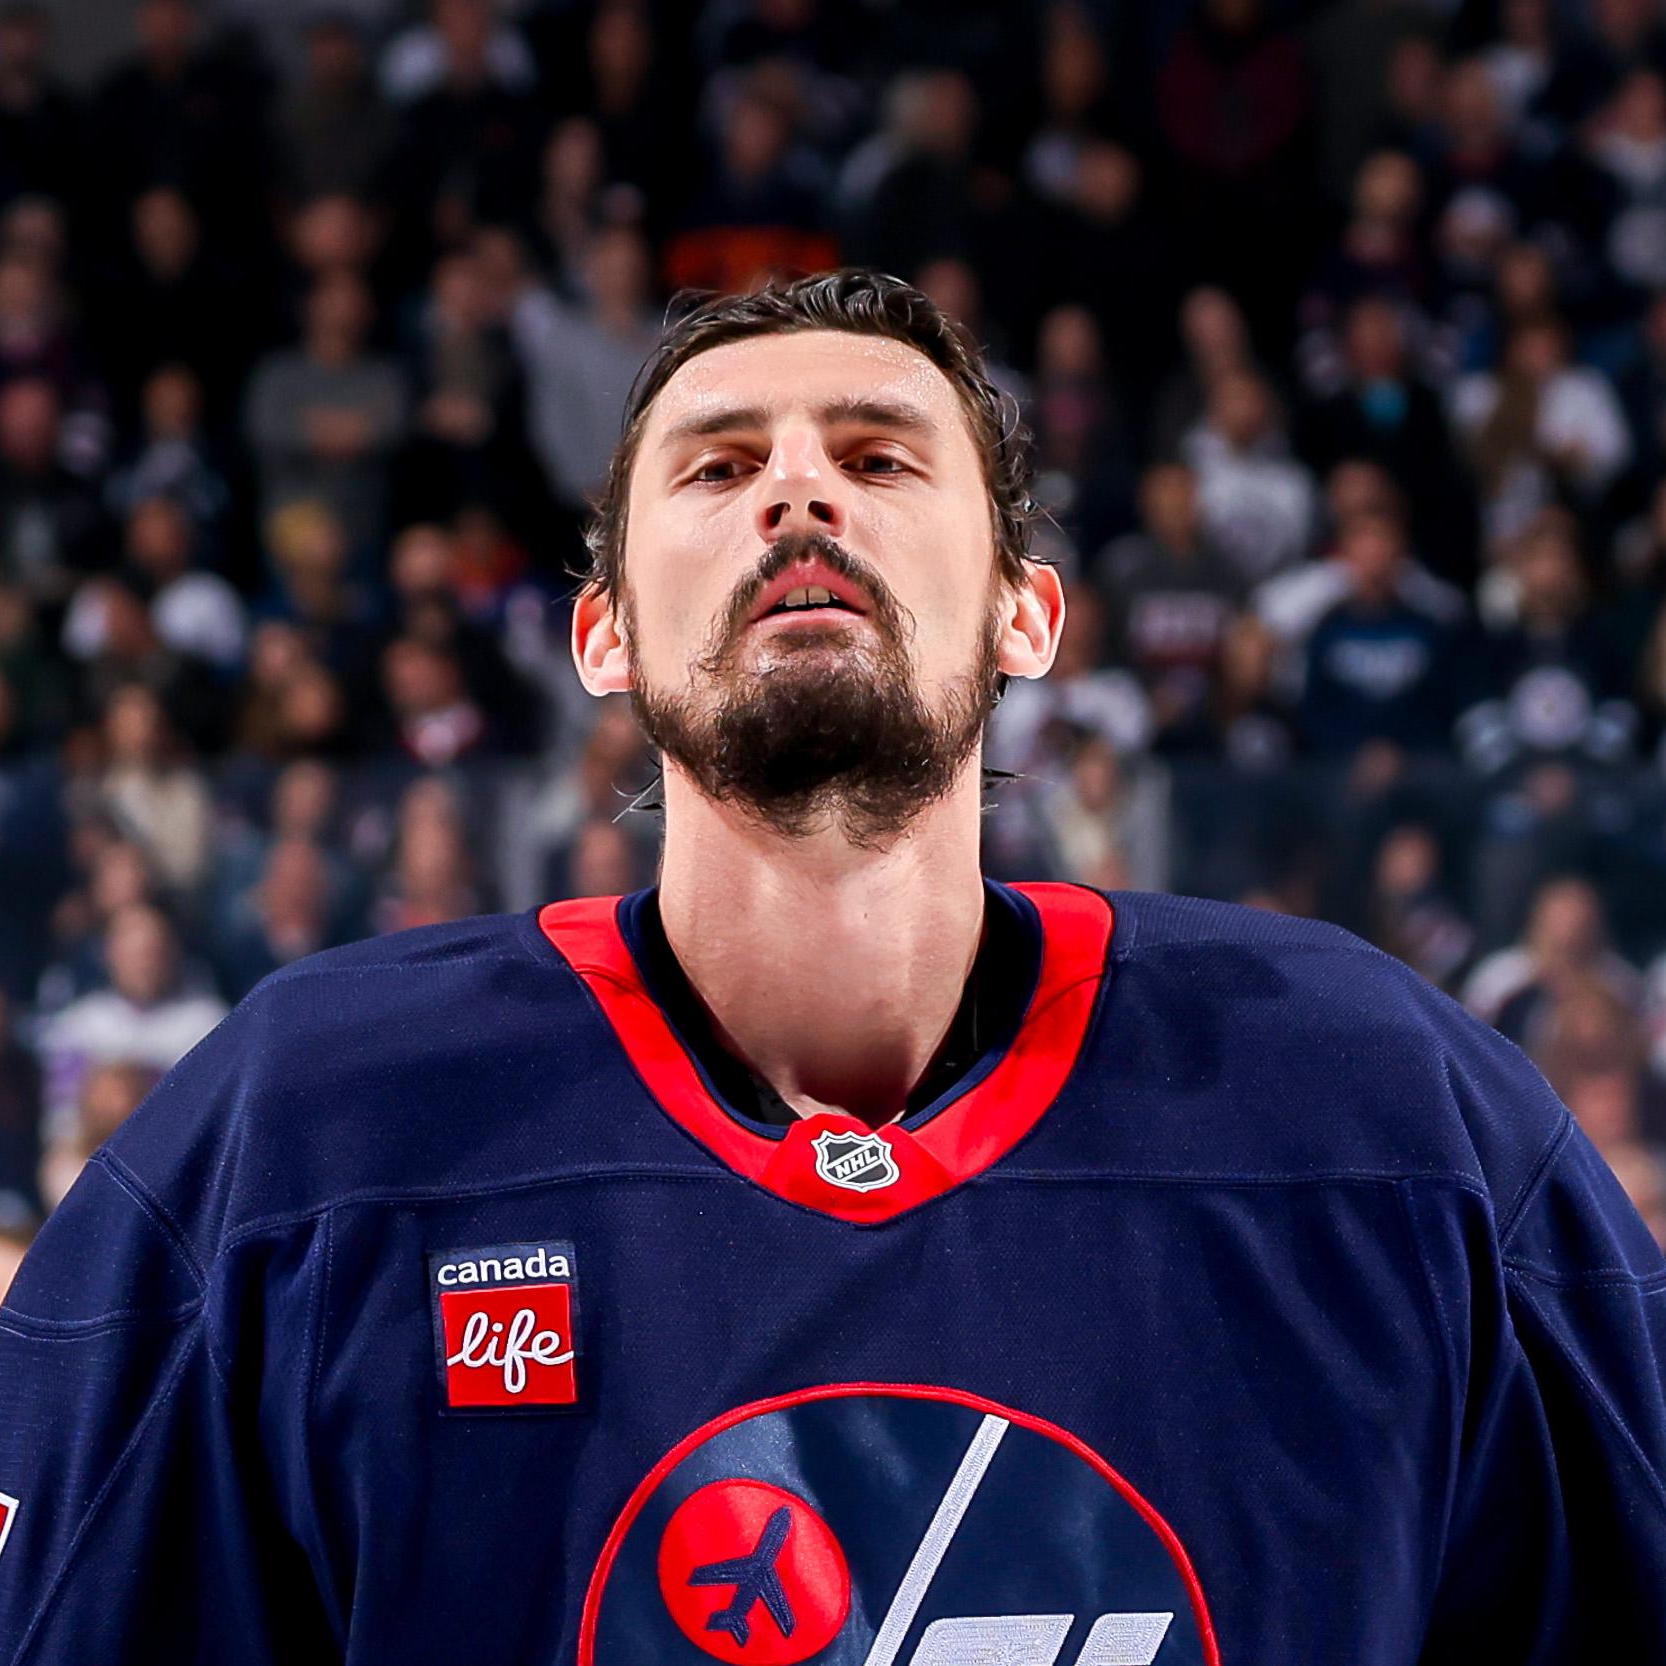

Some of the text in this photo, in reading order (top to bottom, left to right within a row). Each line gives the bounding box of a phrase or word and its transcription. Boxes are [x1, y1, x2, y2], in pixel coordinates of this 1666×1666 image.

[835, 1149, 879, 1179] NHL
[437, 1248, 570, 1285] canada
[446, 1309, 574, 1393] life
